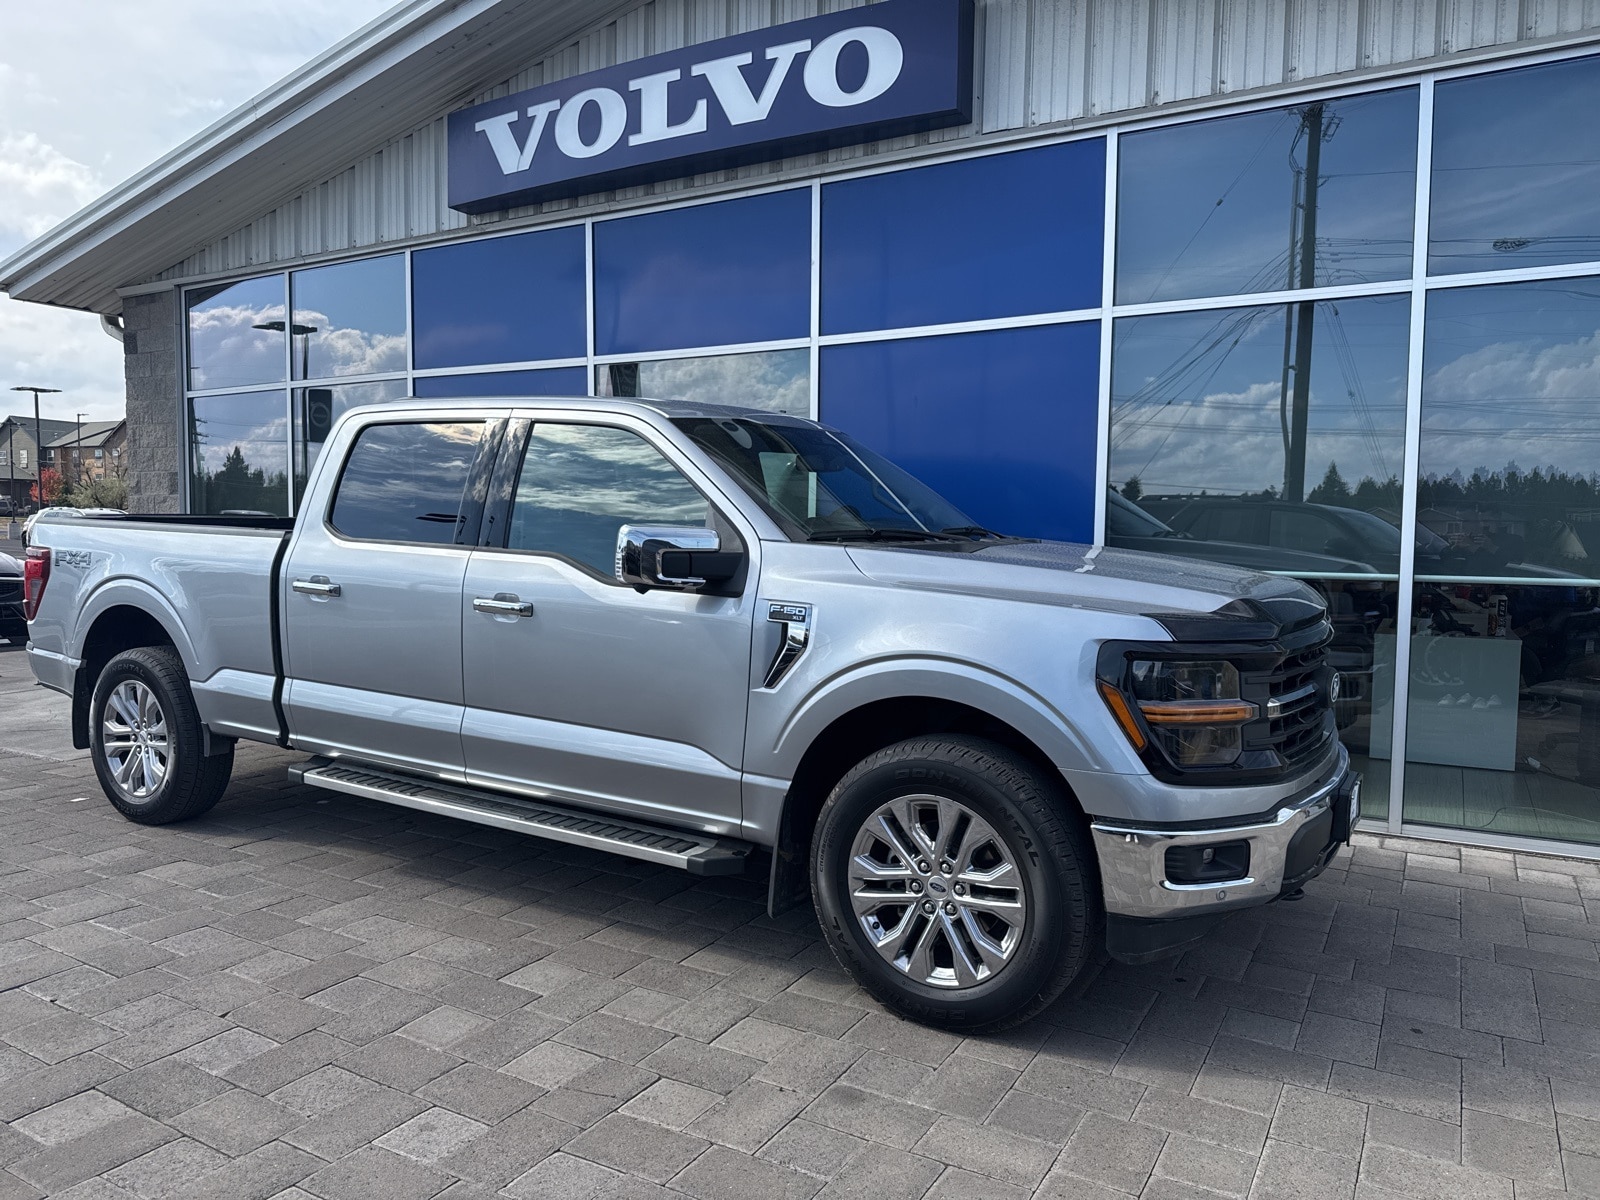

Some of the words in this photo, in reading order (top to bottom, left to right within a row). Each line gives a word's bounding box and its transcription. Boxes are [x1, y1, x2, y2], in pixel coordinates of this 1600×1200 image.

[475, 26, 903, 174] VOLVO
[55, 550, 92, 566] FX4
[770, 605, 805, 615] F-150
